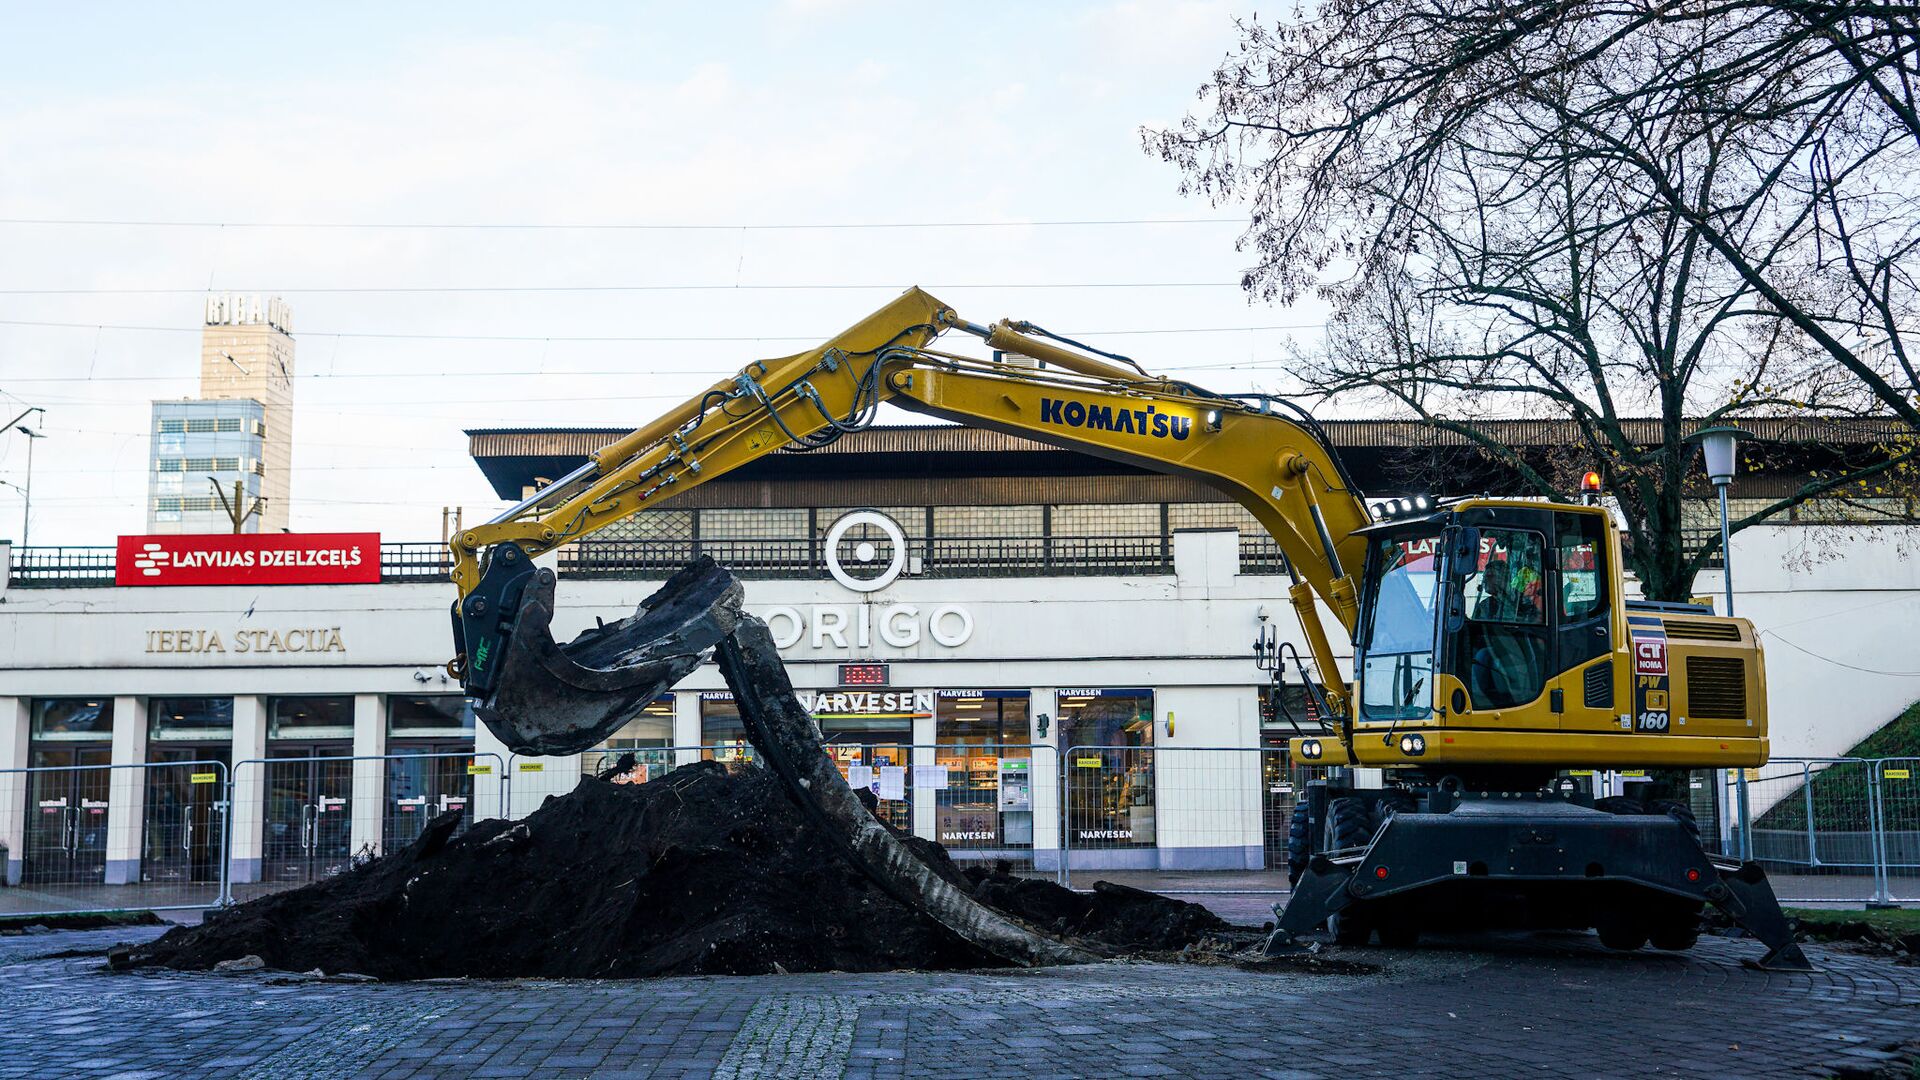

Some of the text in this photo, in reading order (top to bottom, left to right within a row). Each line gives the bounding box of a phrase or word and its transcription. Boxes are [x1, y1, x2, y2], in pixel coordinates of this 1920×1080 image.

[1041, 398, 1191, 441] KOMATSU
[173, 545, 362, 570] LATVIJAS DZELZCEĻŠ
[764, 604, 974, 649] ORIGO
[145, 627, 346, 653] IEEJA STACIJĀ
[1639, 660, 1662, 669] NOMA
[1638, 676, 1661, 689] PW
[795, 692, 933, 711] NARVESEN
[940, 690, 983, 698] NARVESEN
[1638, 712, 1668, 729] 160
[942, 832, 995, 840] NARVESEN
[1080, 831, 1133, 839] NARVESEN
